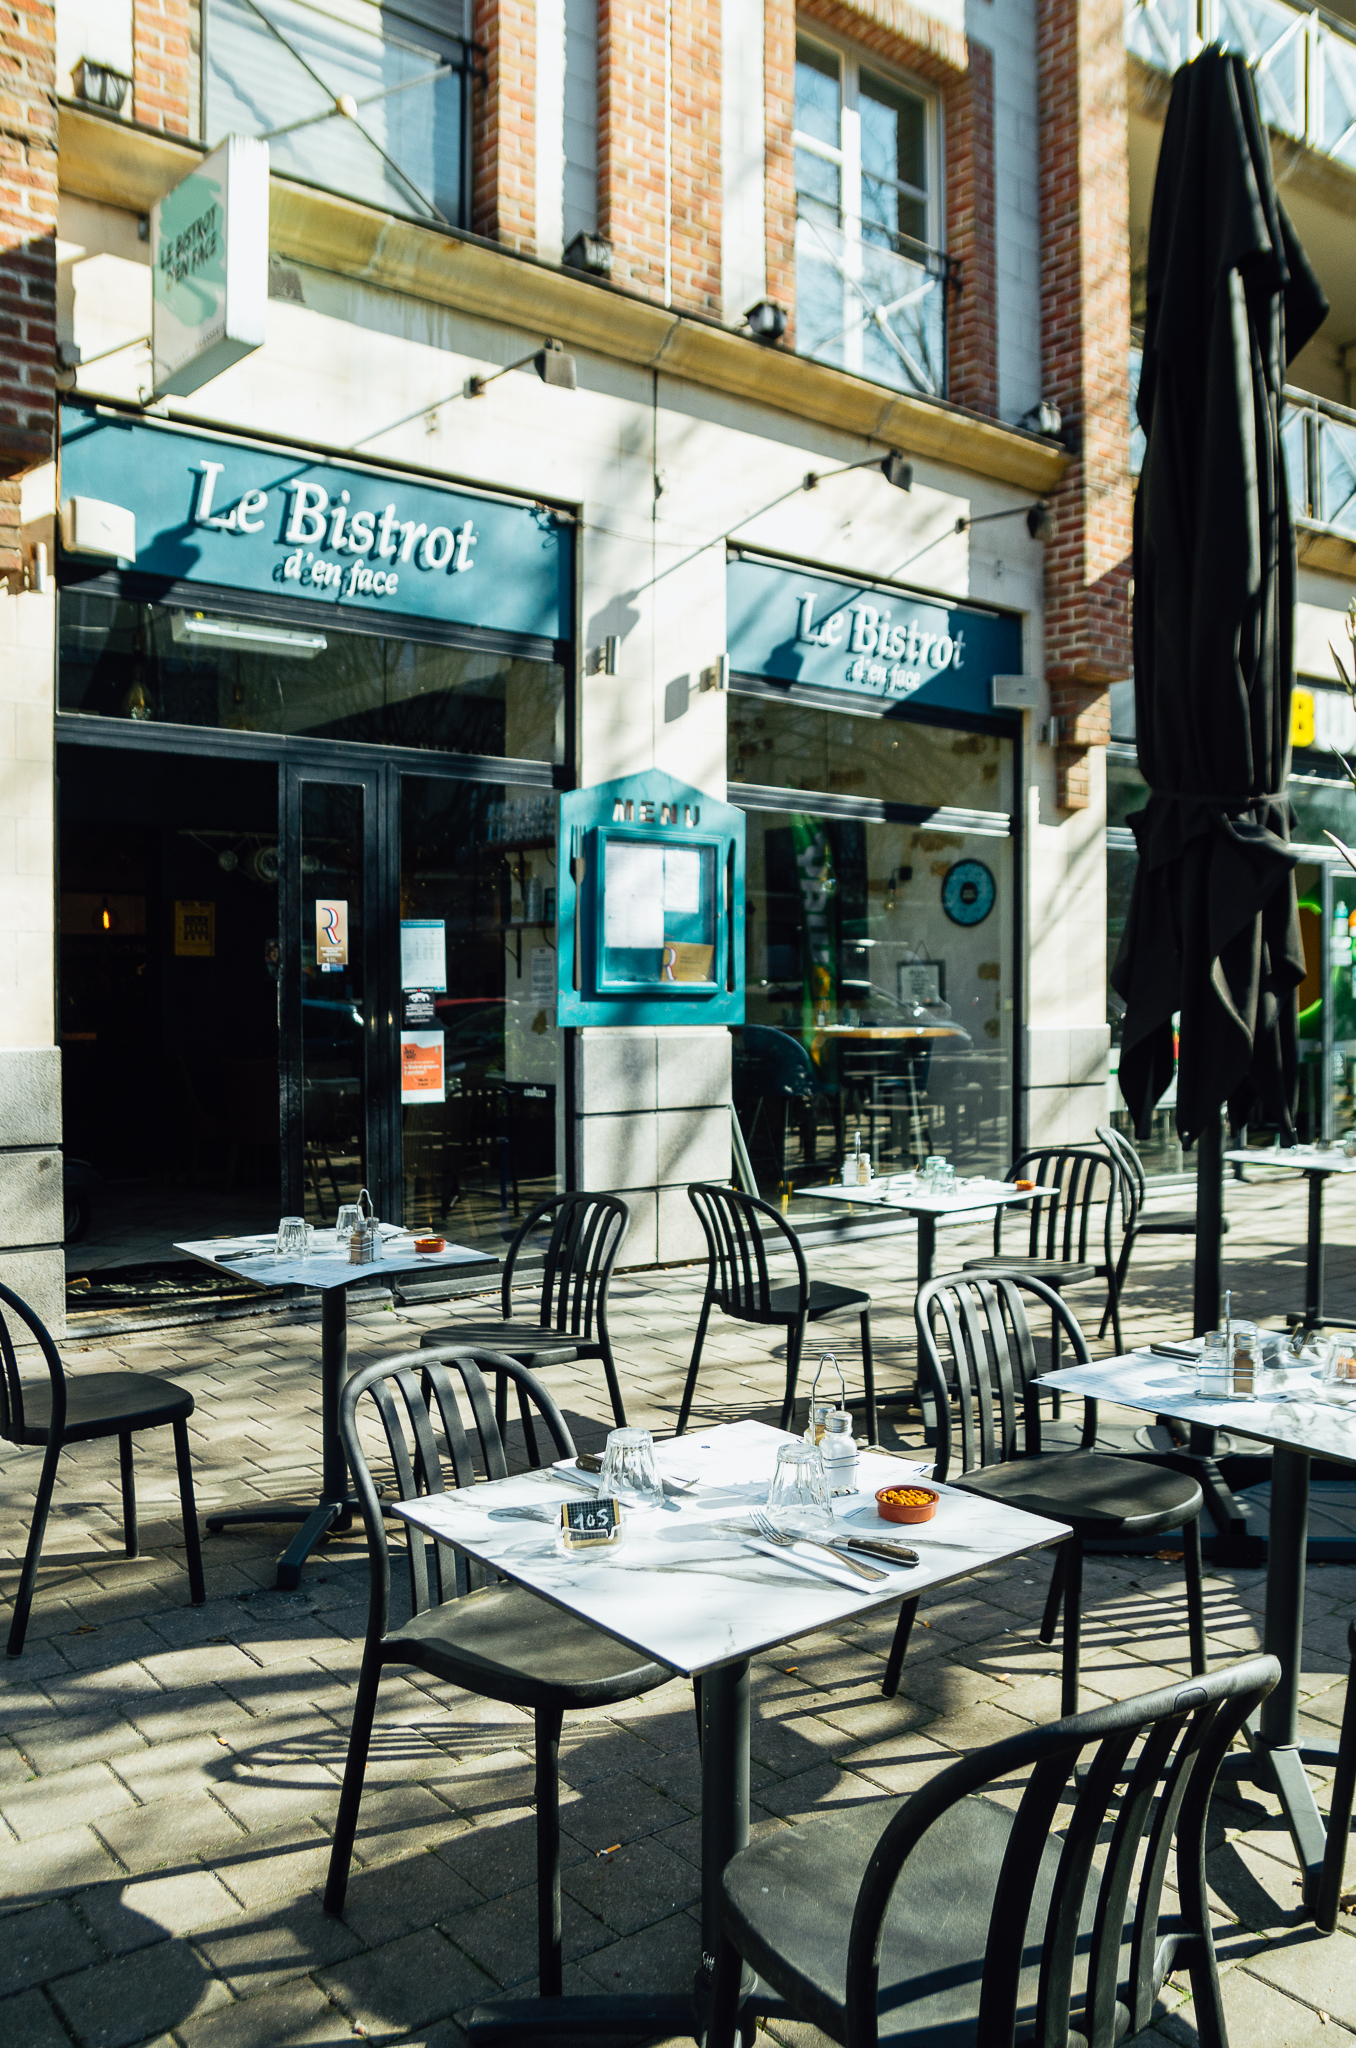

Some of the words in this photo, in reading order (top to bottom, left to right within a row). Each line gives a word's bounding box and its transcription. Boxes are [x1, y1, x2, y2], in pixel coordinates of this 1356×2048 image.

[160, 242, 173, 272] LE
[194, 459, 268, 534] Le
[287, 478, 478, 573] Bistrot
[282, 547, 342, 587] d'en
[344, 557, 399, 596] face
[799, 591, 845, 647] Le
[853, 602, 966, 672] Bistrot
[852, 654, 887, 683] d'en
[887, 662, 921, 692] face
[612, 797, 701, 828] MENU
